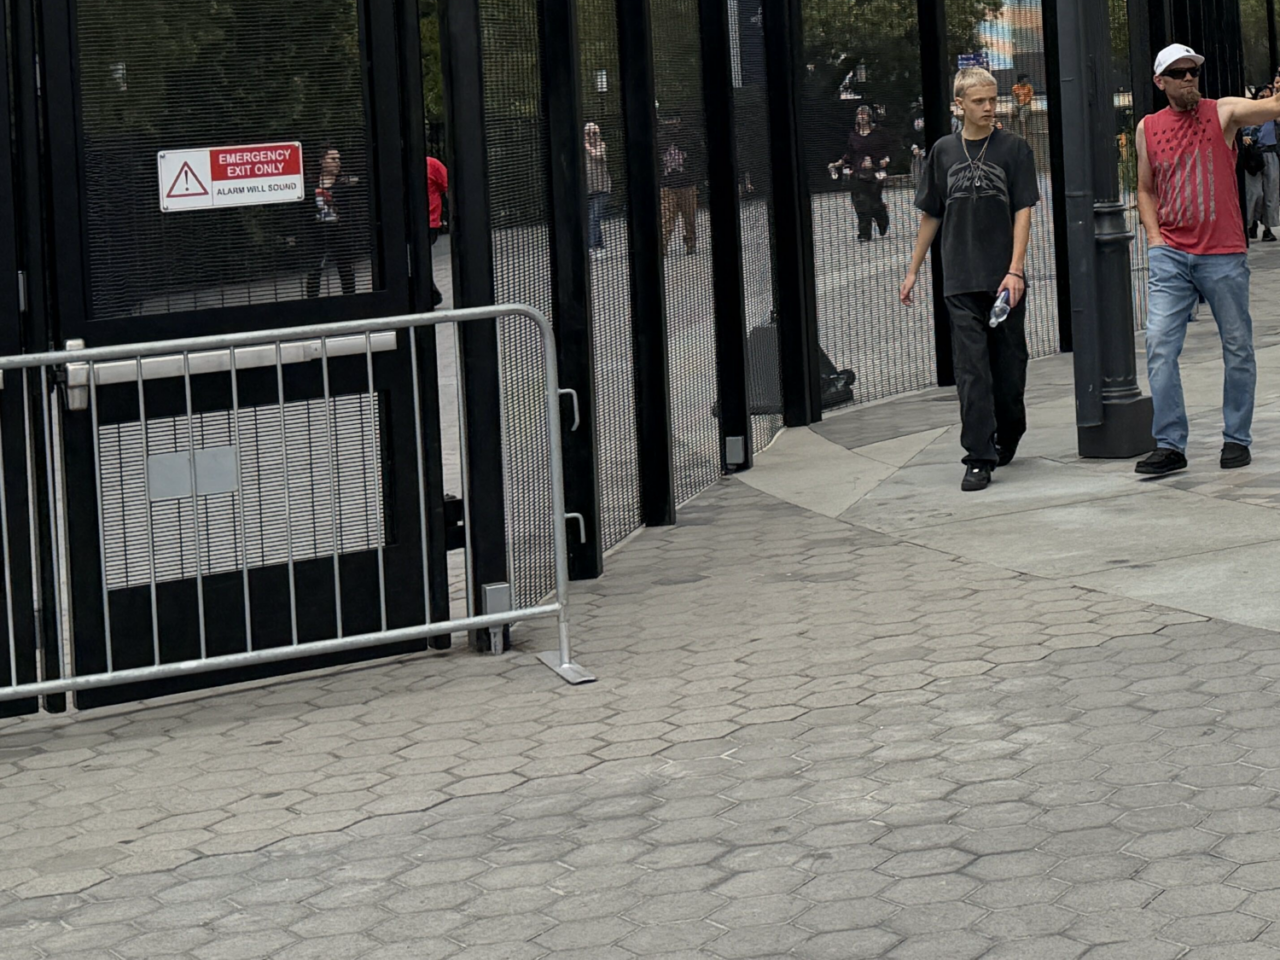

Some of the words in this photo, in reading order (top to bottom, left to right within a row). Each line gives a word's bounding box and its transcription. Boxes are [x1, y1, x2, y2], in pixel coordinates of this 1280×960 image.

[219, 149, 291, 164] EMERGENCY
[227, 165, 251, 177] EXIT
[254, 162, 285, 175] ONLY
[217, 185, 245, 196] ALARM
[247, 184, 266, 194] WILL
[268, 182, 297, 192] SOUND
